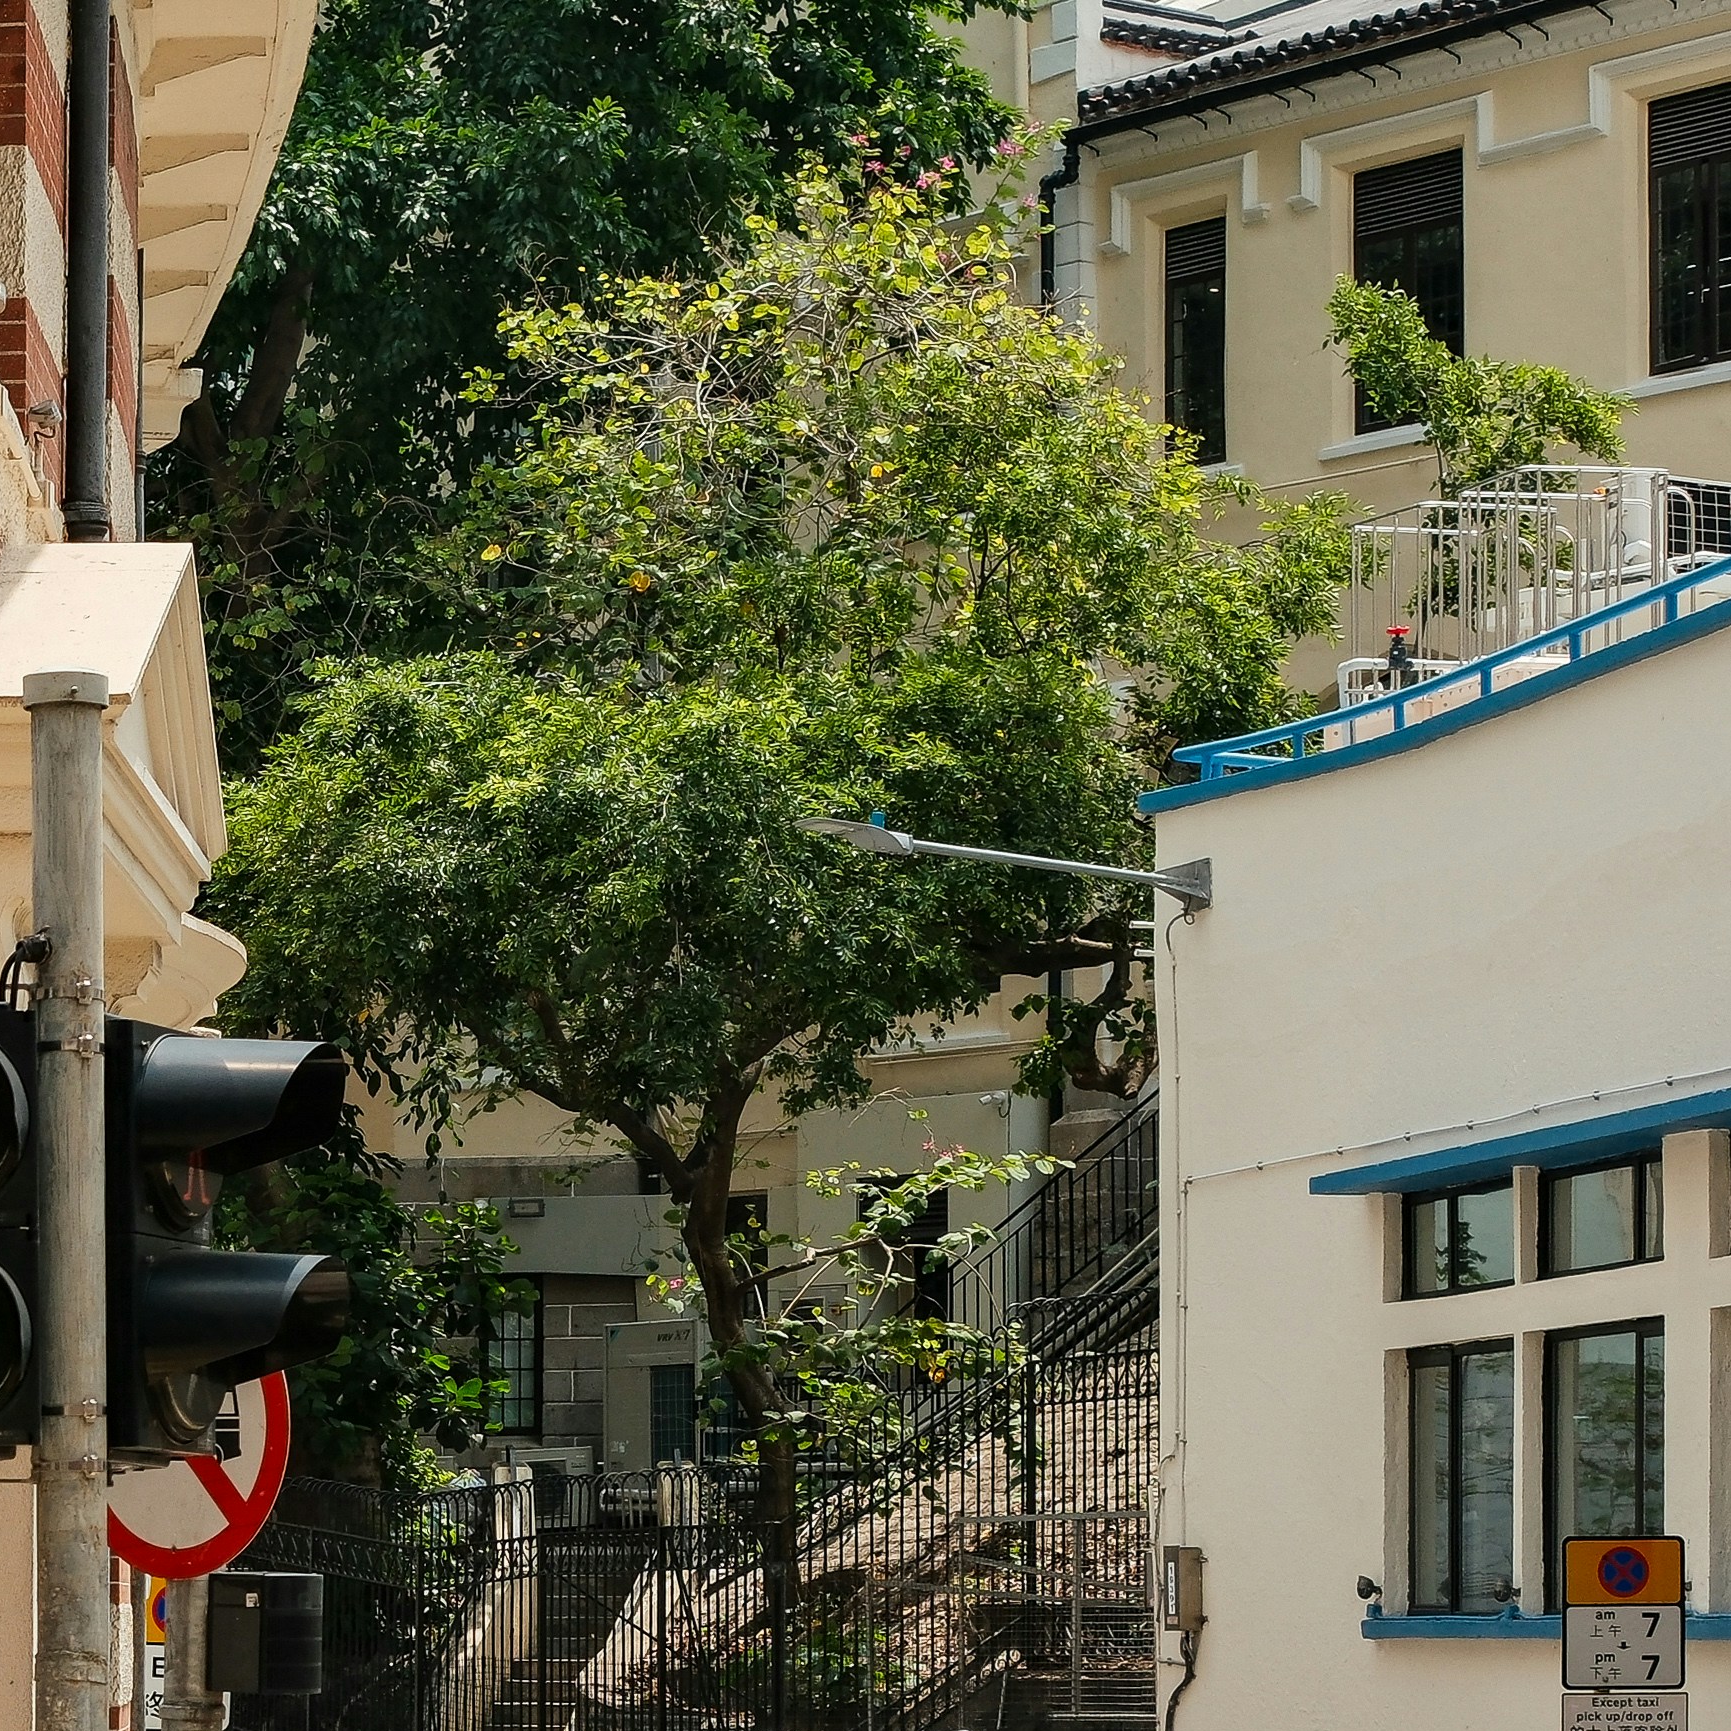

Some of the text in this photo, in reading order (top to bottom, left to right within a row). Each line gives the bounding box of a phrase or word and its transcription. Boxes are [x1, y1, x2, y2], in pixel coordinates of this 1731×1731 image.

[1589, 1624, 1622, 1638] 上午
[1595, 1610, 1660, 1638] am 7
[1594, 1653, 1660, 1680] pm 7
[1589, 1667, 1622, 1681] 下午
[1591, 1697, 1660, 1710] Except taxi
[1576, 1710, 1674, 1724] pick up/drop off
